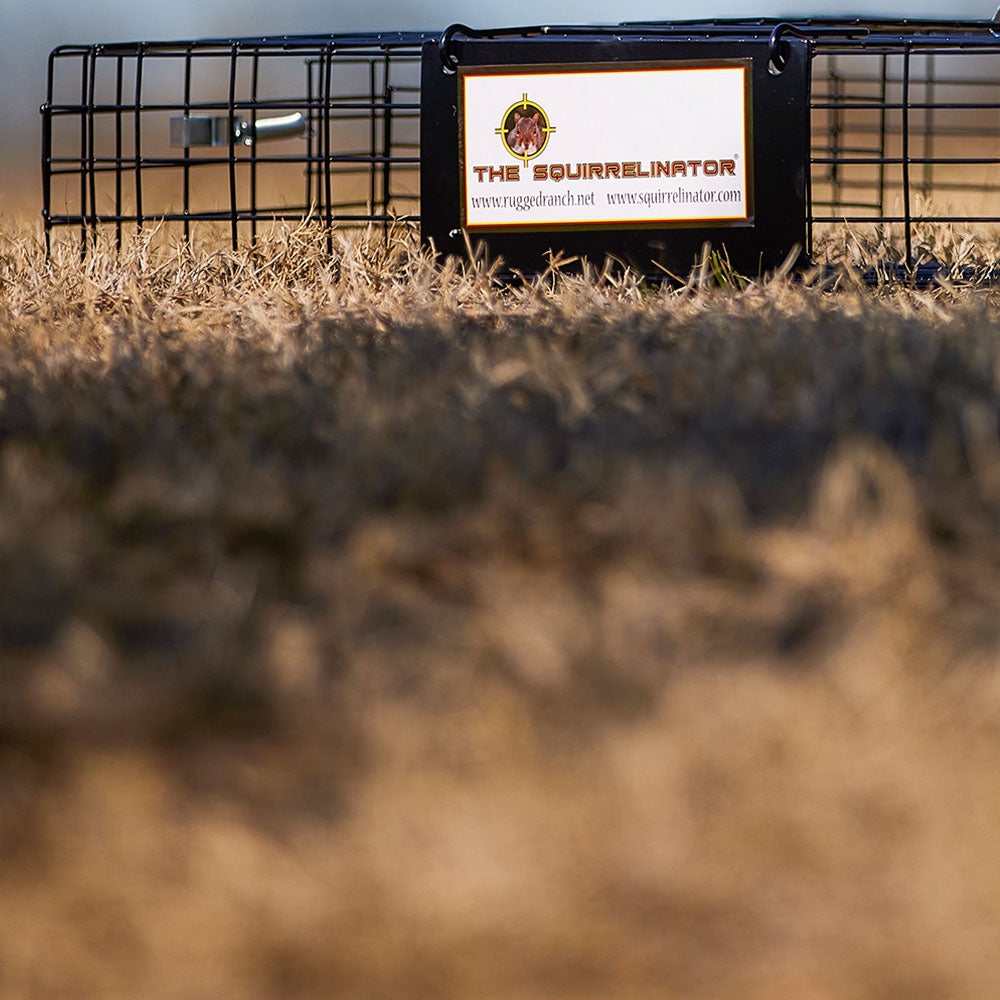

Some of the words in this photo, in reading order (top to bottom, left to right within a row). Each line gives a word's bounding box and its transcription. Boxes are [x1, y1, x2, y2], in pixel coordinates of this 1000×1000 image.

[473, 165, 520, 183] THE
[532, 159, 736, 183] SQUIRRELINATOR
[471, 190, 596, 211] www.ruggedranch.net
[606, 187, 742, 208] www.squirrelinator.com
